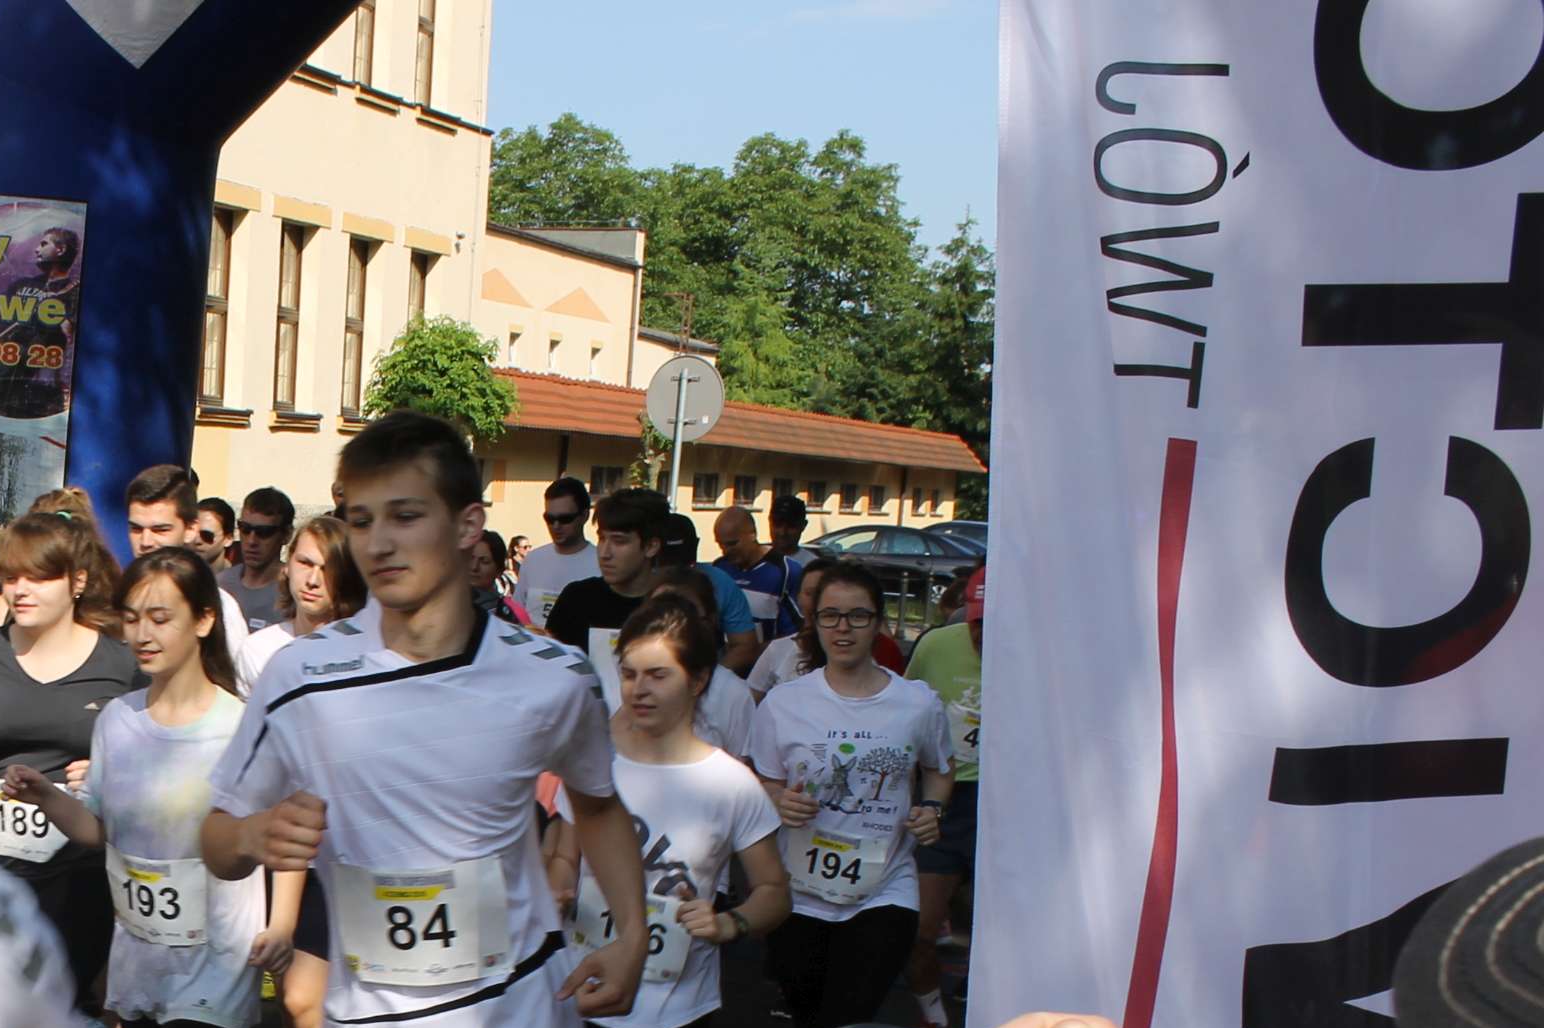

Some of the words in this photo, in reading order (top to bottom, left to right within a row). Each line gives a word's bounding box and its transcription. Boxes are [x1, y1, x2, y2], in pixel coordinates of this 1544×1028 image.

[26, 344, 64, 370] 28
[805, 847, 862, 886] 194
[121, 878, 182, 921] 193
[386, 902, 458, 951] 84
